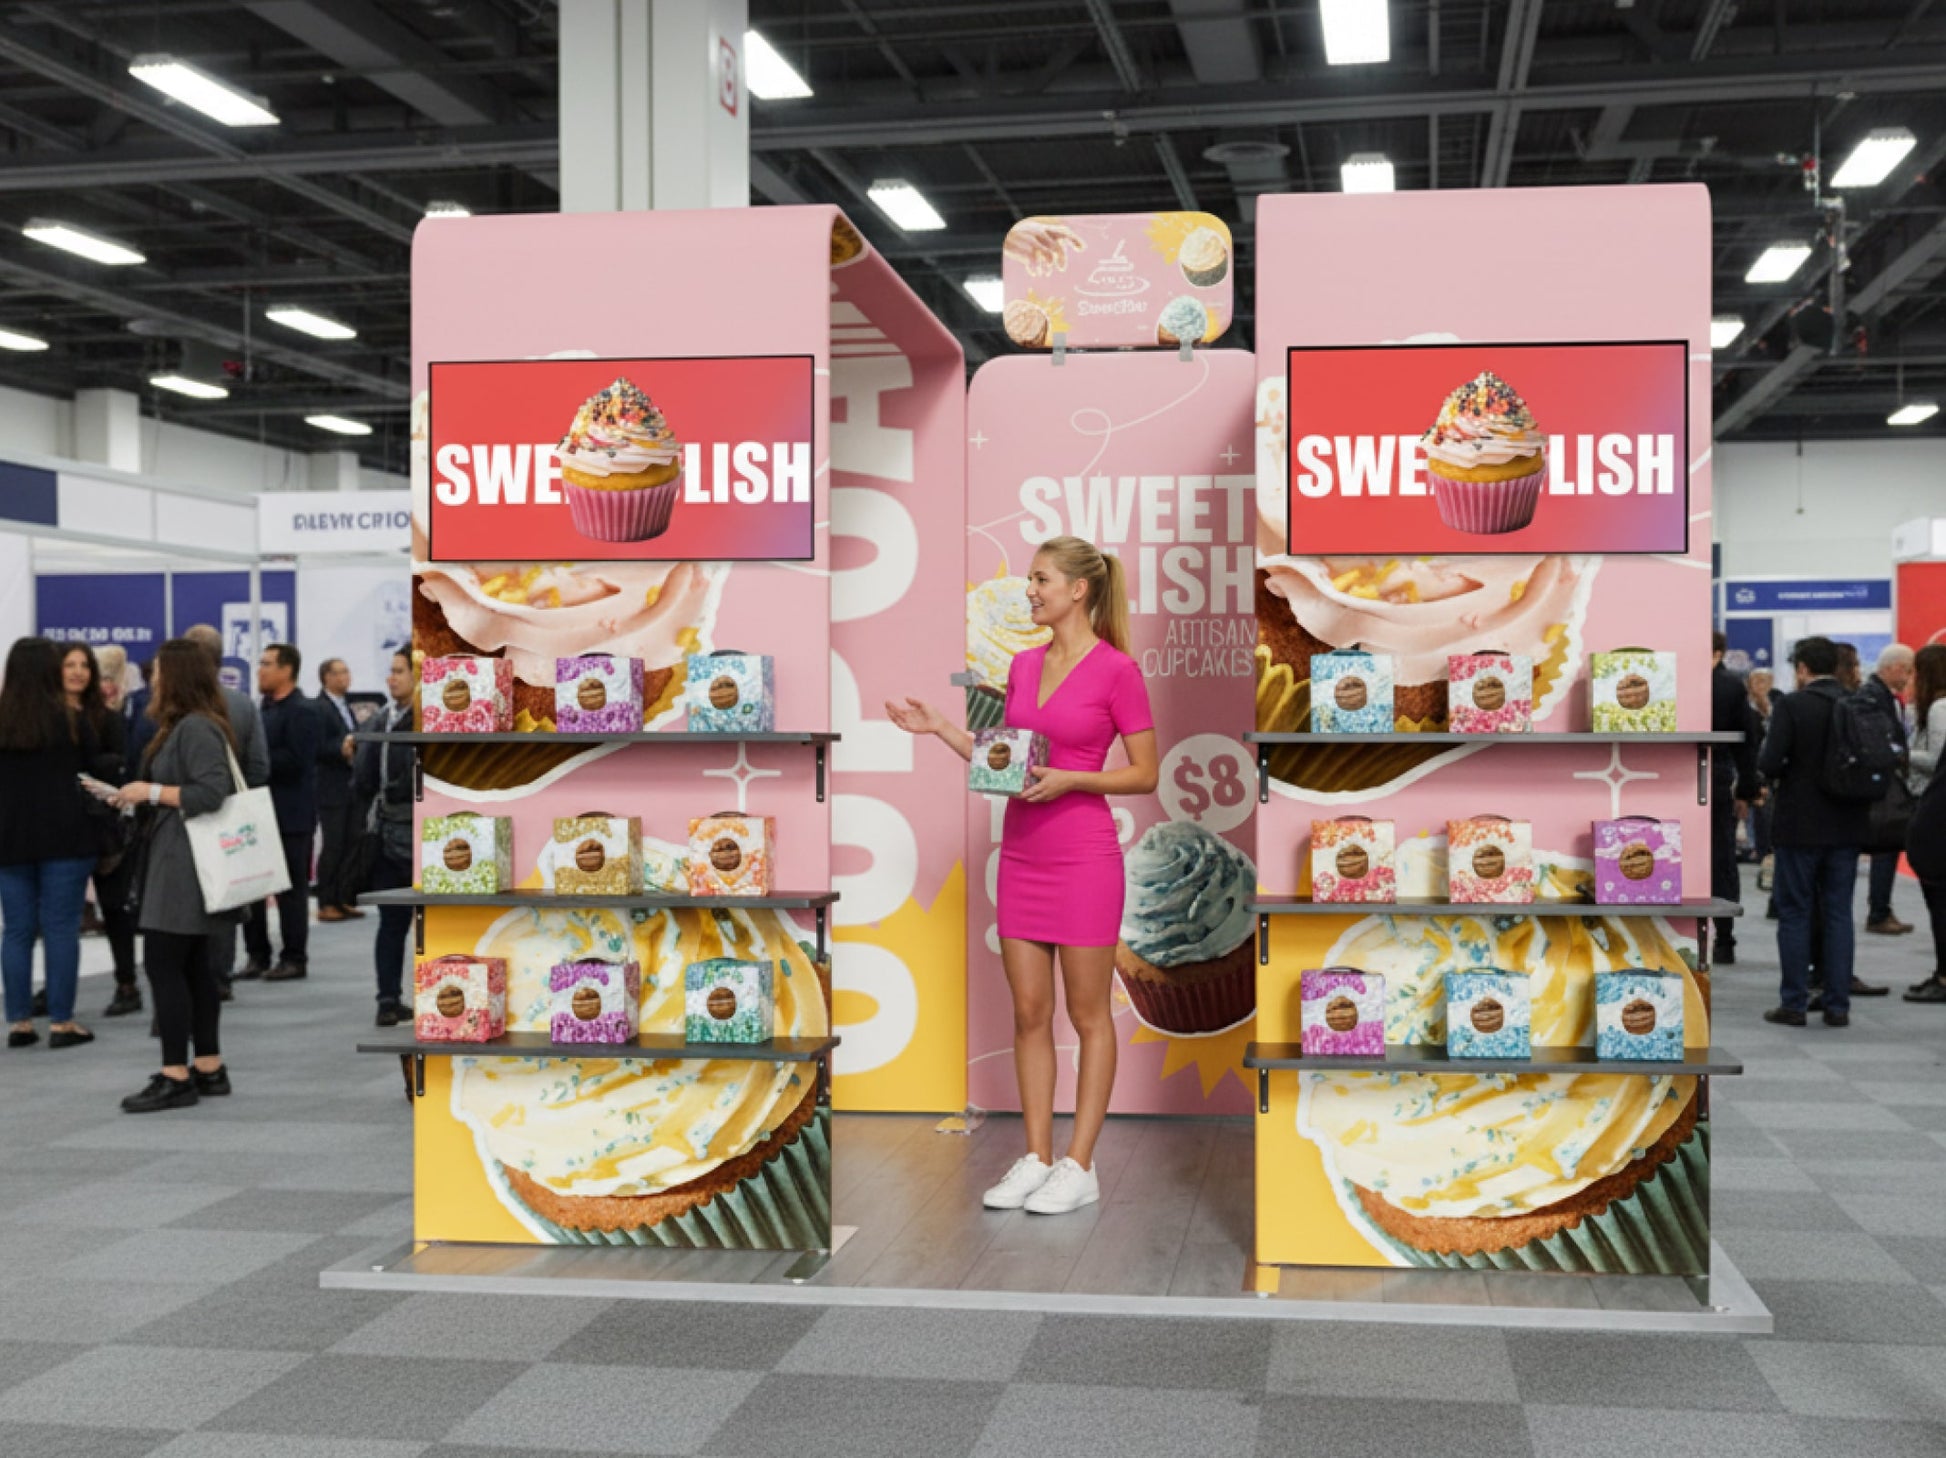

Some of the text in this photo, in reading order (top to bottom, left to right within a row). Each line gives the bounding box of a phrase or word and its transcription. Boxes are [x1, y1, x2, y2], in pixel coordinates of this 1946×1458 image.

[436, 441, 811, 506] SWE LISH
[1297, 433, 1674, 498] SWE LISH
[1019, 475, 1256, 545] SWEET
[1127, 546, 1255, 614] ISH
[1174, 753, 1246, 822] $8
